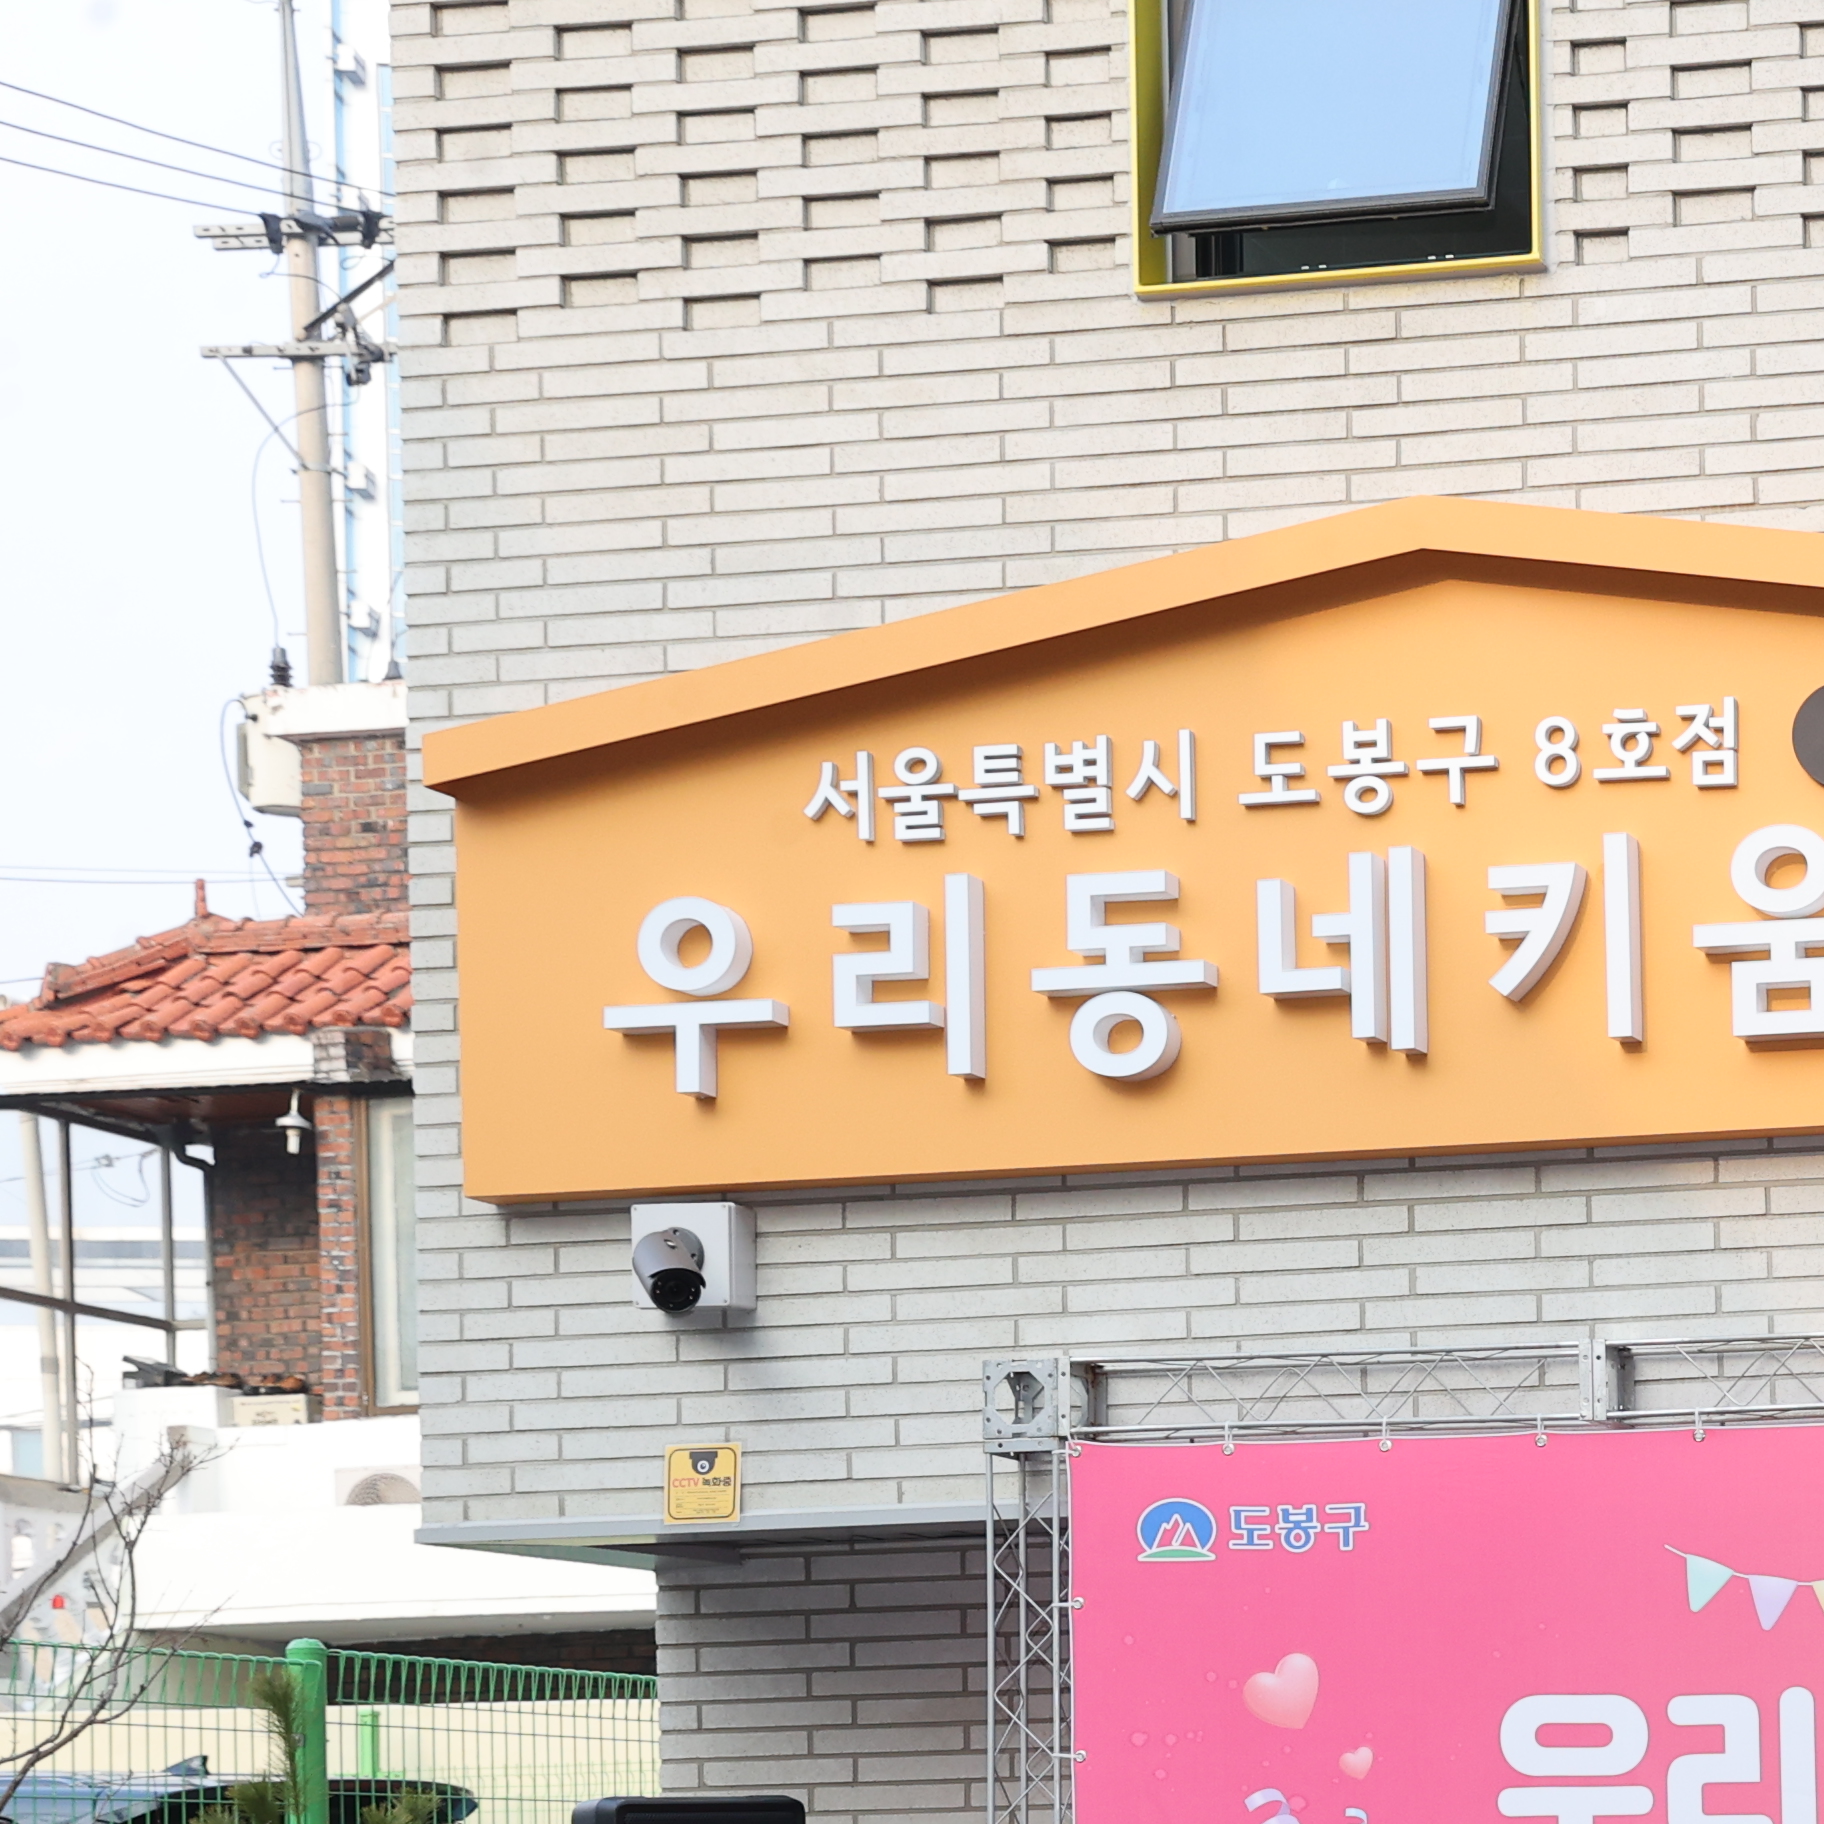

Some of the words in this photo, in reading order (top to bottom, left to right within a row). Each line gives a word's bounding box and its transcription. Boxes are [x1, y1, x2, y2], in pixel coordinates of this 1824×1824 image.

[803, 727, 1196, 843] 서울특별시
[1237, 714, 1498, 815] 도봉구
[1533, 695, 1740, 788] 8호점
[672, 1477, 700, 1488] CCTV
[1228, 1502, 1369, 1552] 도봉구
